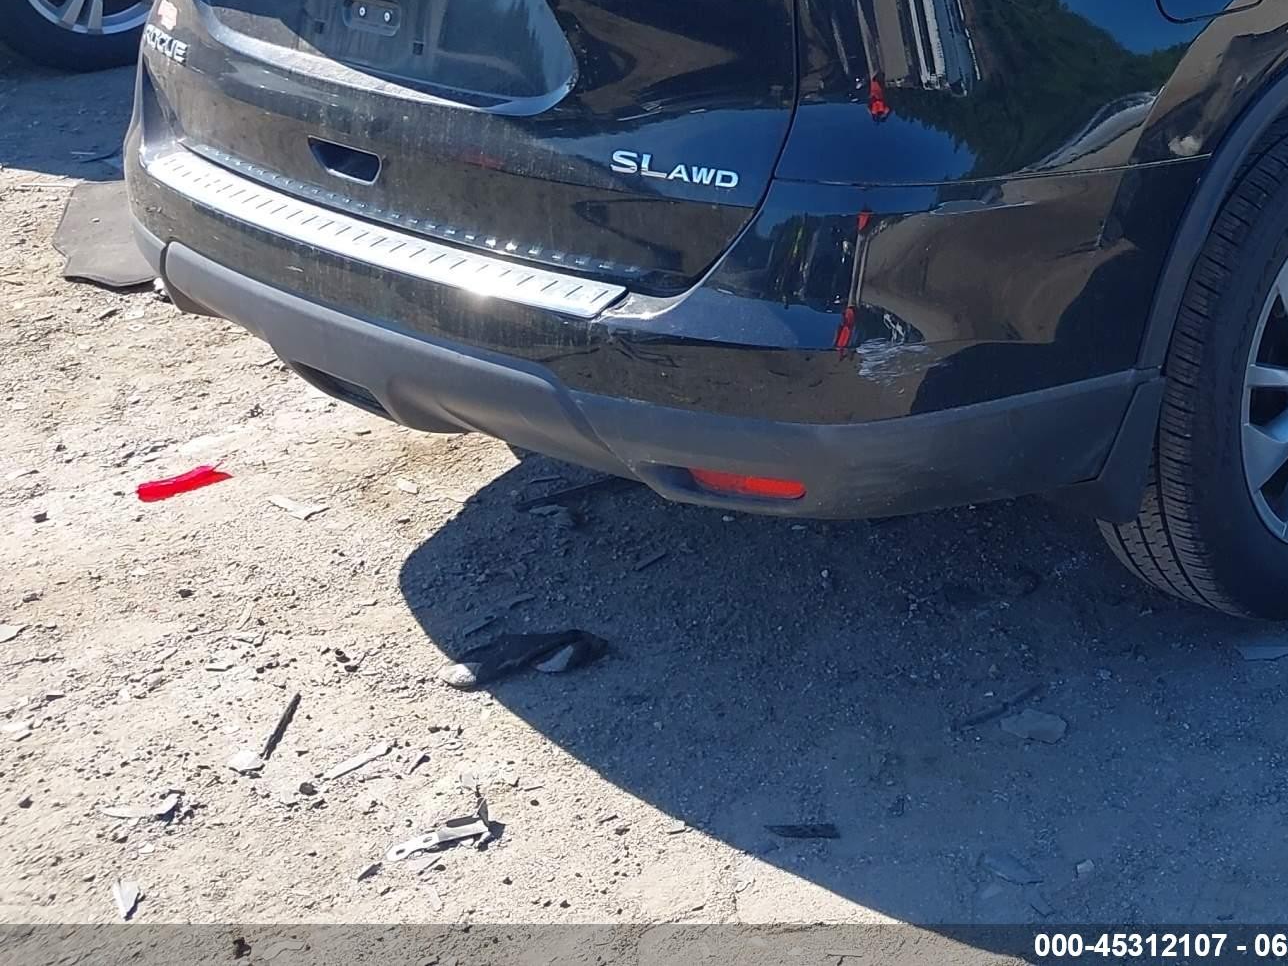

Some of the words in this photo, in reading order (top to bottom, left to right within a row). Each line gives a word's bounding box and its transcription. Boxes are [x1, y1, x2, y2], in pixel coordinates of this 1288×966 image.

[143, 23, 188, 64] ROGUE
[610, 149, 667, 179] SL
[667, 163, 739, 189] AWD
